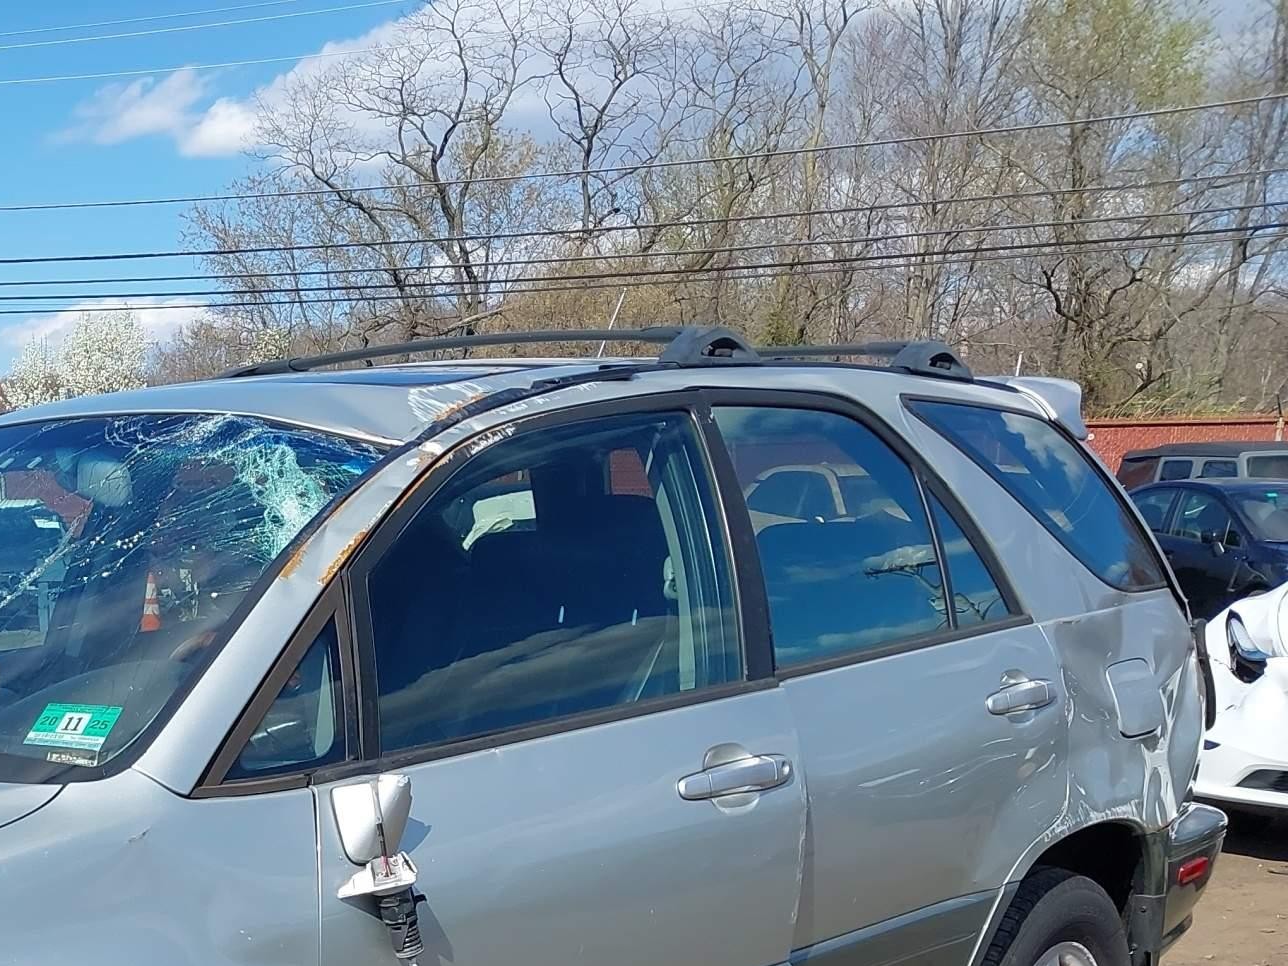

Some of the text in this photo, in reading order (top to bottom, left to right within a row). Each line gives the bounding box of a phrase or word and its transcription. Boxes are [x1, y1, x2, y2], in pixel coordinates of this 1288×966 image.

[40, 716, 109, 731] 20 11 25
